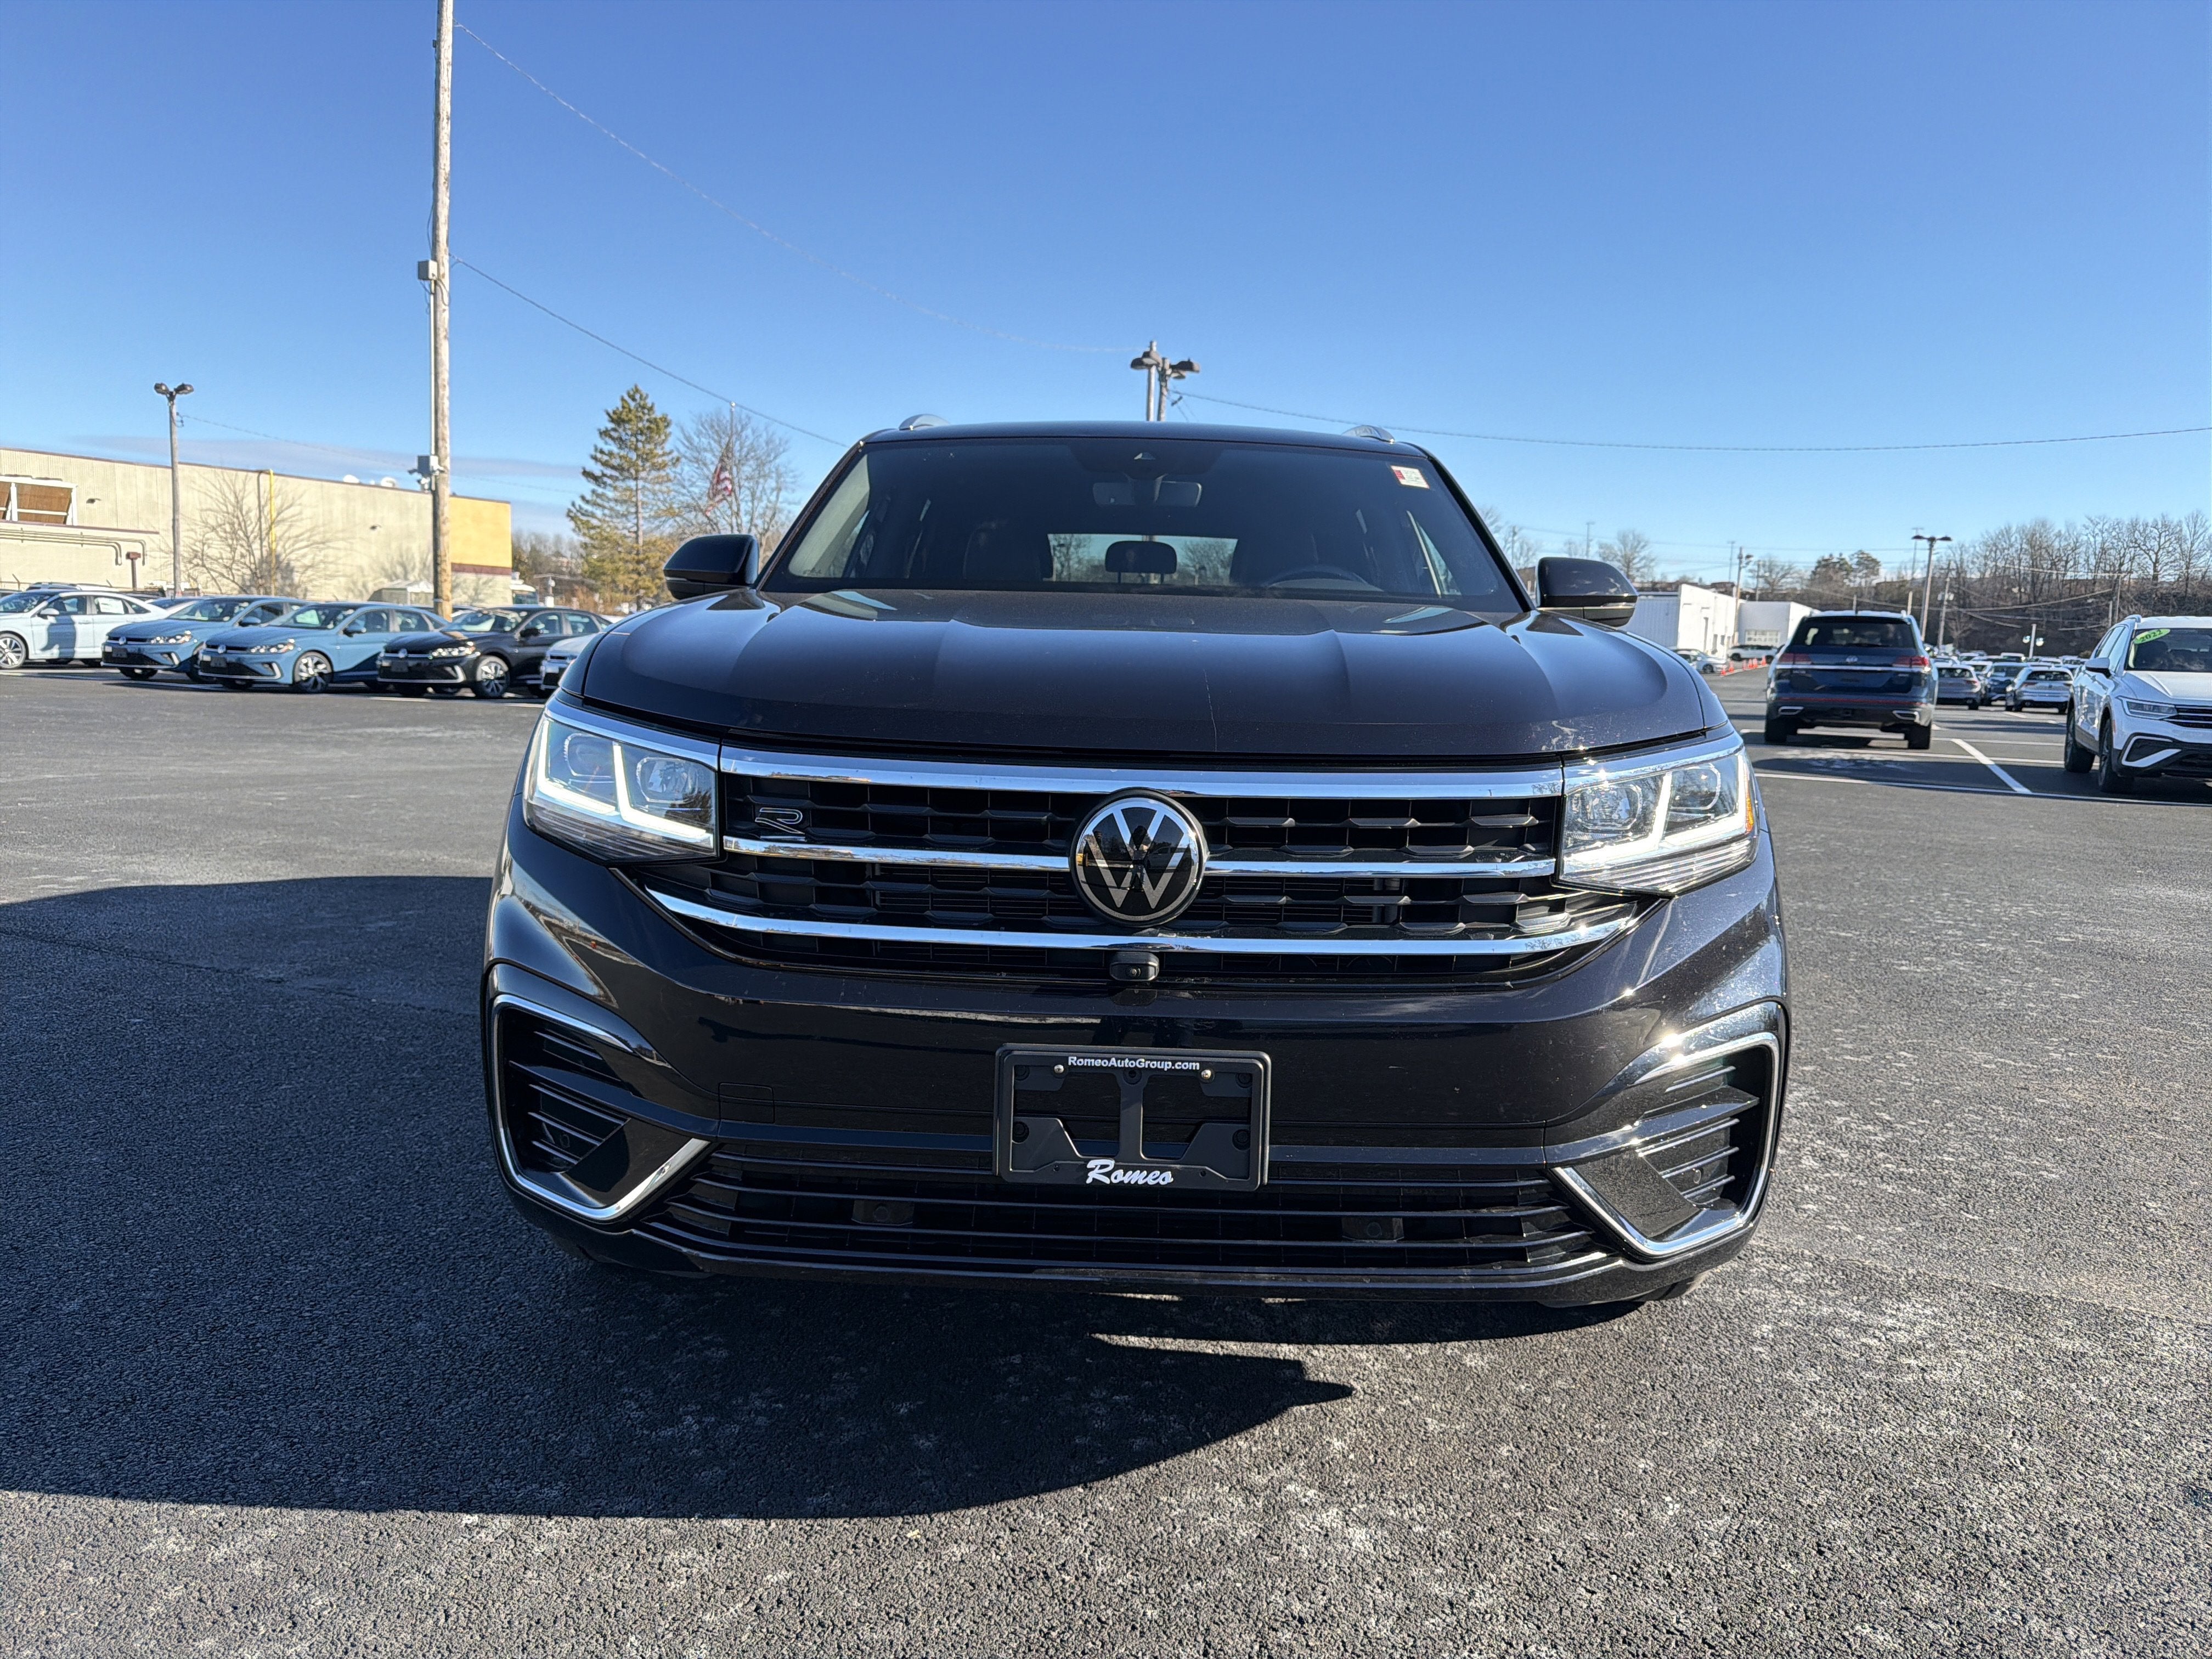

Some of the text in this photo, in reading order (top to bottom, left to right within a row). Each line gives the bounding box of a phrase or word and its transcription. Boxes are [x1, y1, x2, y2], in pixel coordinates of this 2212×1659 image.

[2140, 630, 2163, 642] 2022
[1068, 1056, 1200, 1071] RomeoAutoGroup.com
[1086, 1159, 1174, 1186] Romeo
